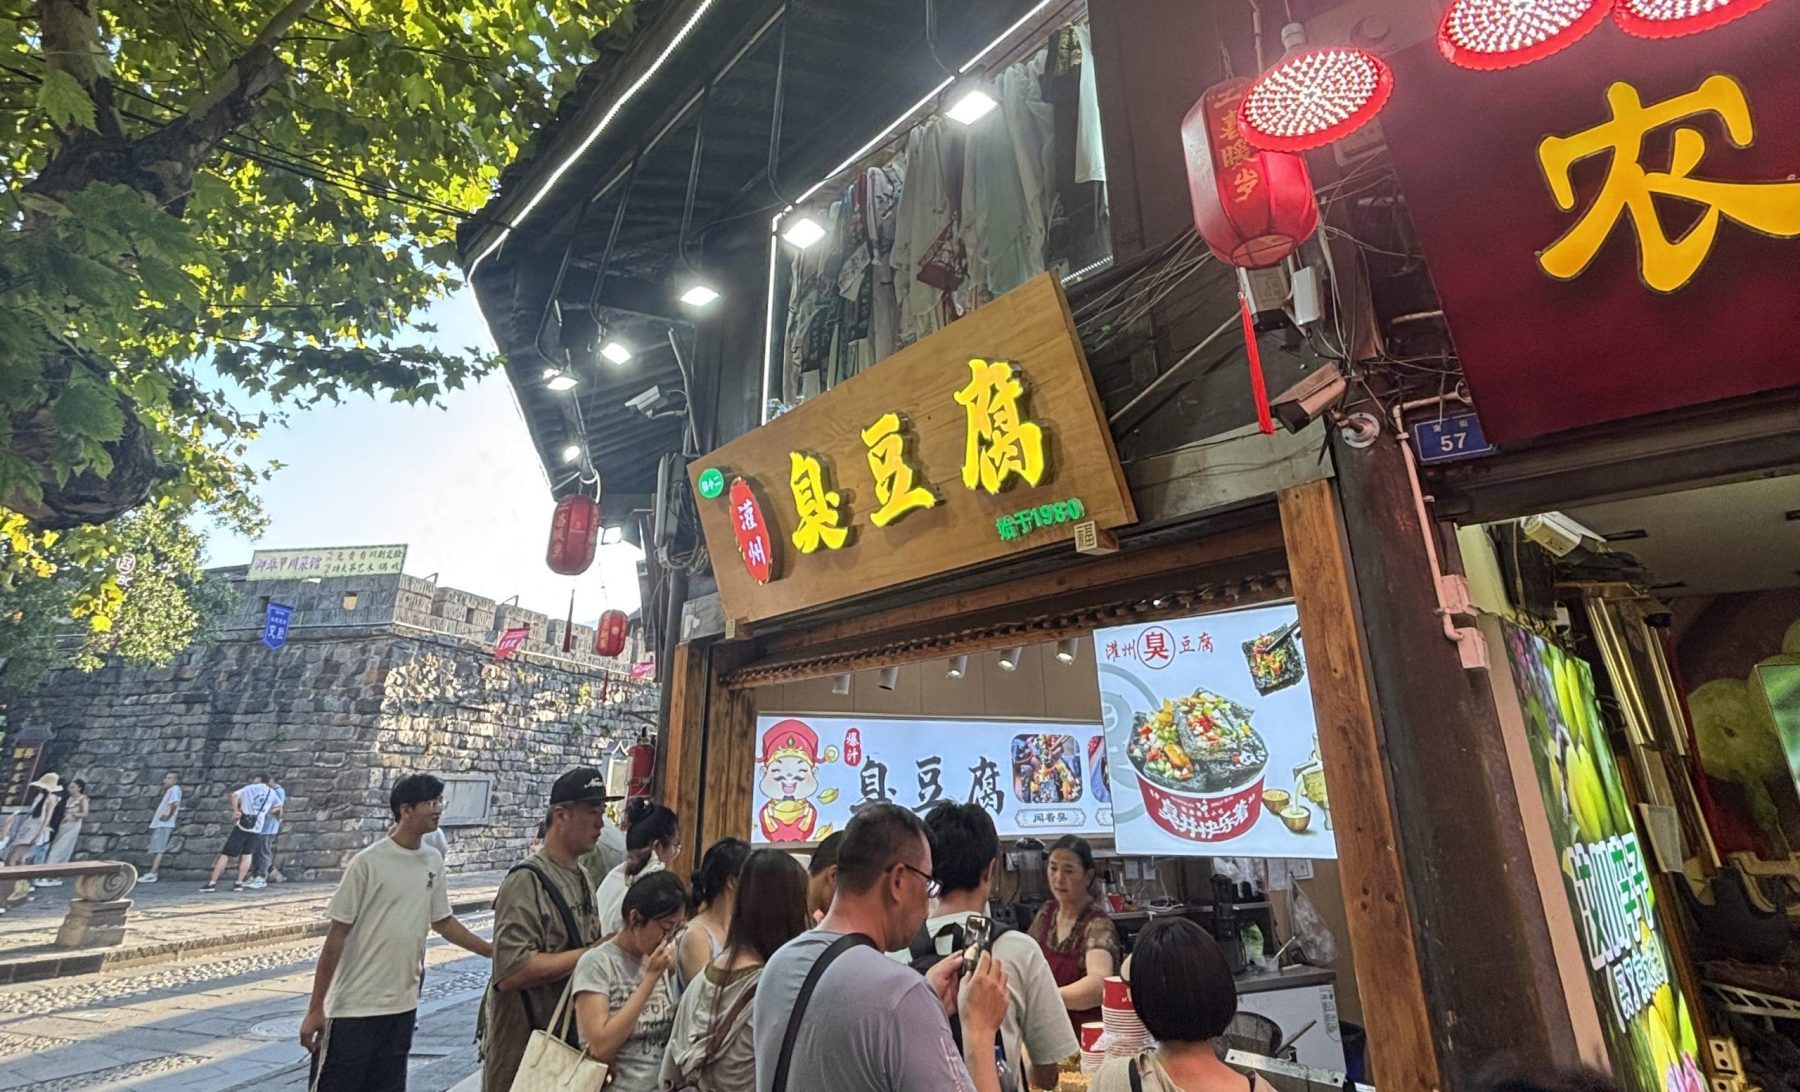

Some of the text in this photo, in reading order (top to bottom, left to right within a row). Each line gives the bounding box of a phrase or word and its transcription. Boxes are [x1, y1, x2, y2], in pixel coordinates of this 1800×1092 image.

[1538, 75, 1800, 292] 农
[789, 358, 1043, 554] 臭豆腐
[1440, 432, 1467, 452] 57
[738, 498, 767, 567] 灌州
[996, 498, 1084, 540] 始于1980
[849, 754, 1005, 816] 臭豆腐
[1566, 831, 1655, 972] 汶川李子
